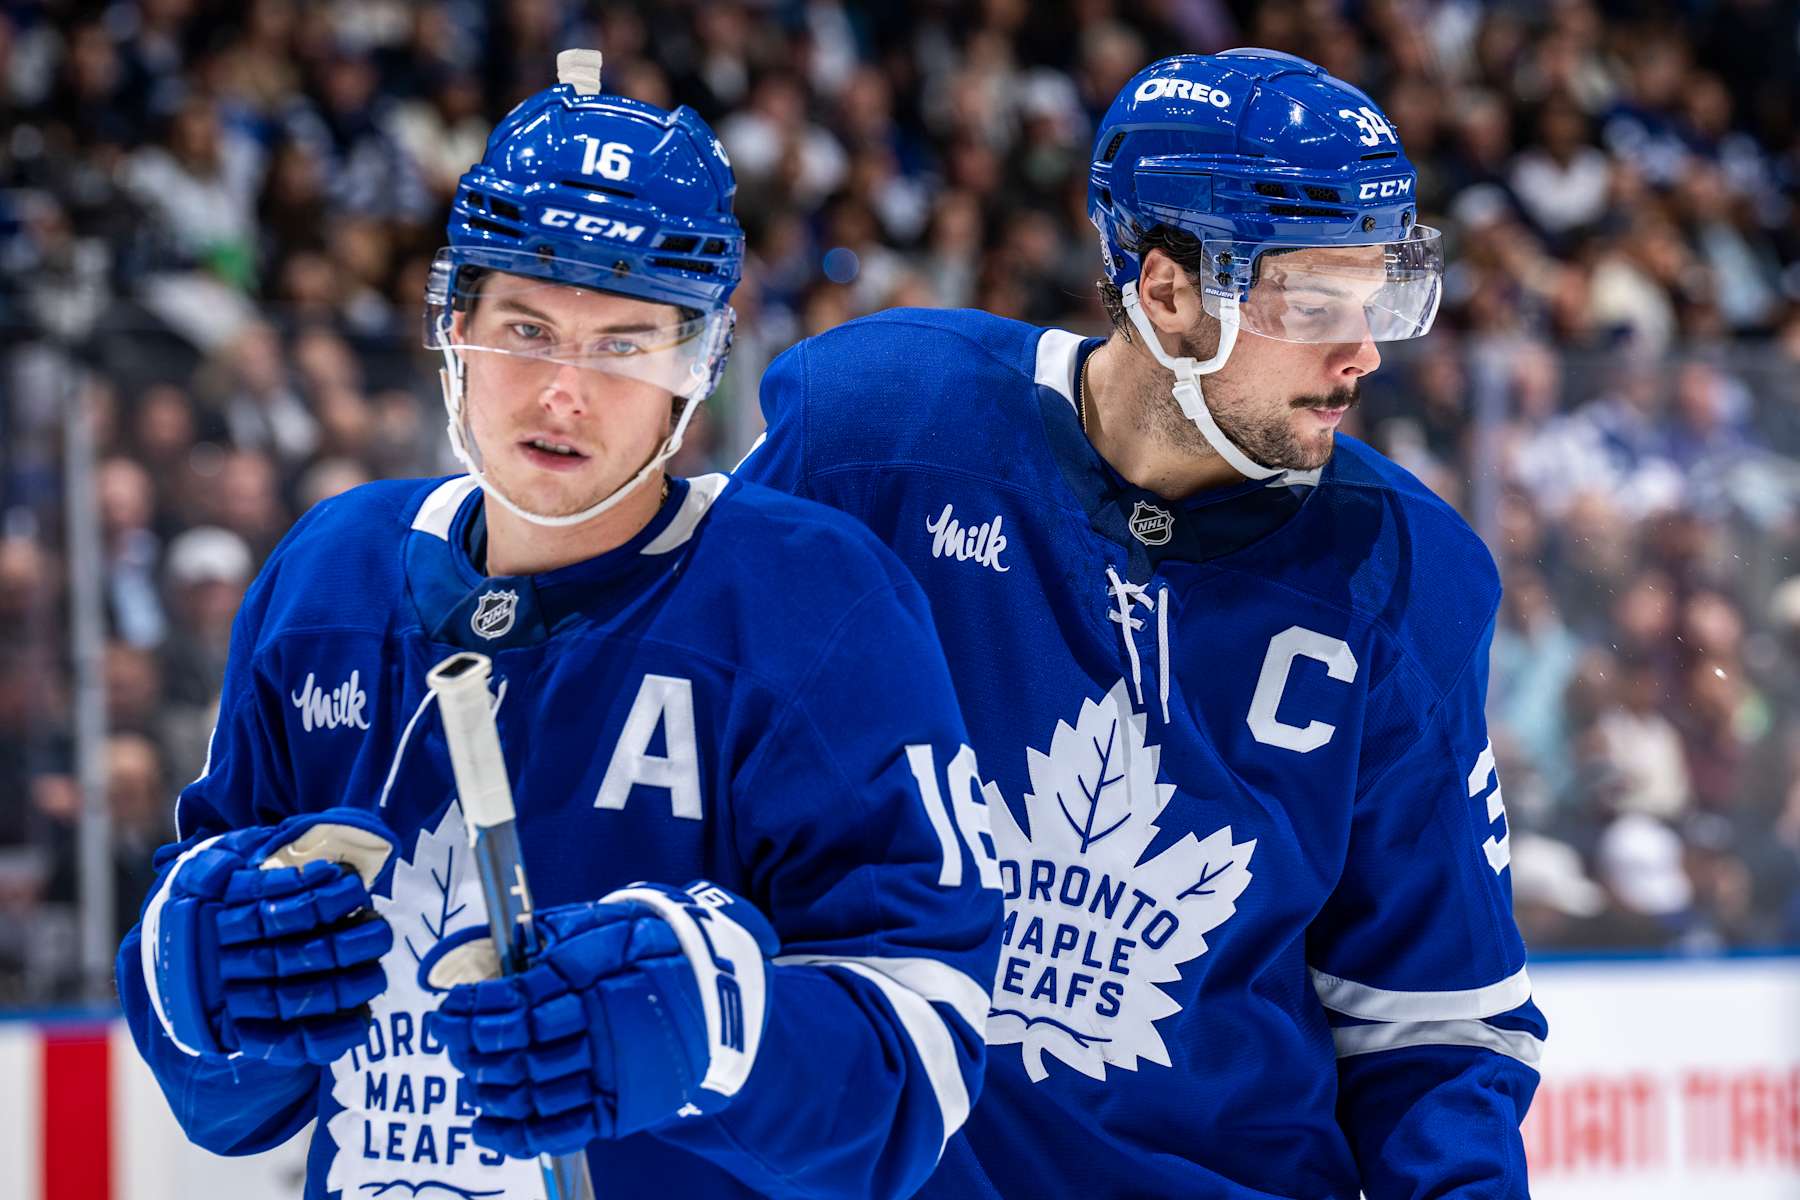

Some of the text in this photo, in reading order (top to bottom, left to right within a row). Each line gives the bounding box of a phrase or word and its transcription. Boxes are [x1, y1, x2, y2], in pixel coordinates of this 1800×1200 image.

[1134, 78, 1231, 109] OREO
[1339, 107, 1397, 147] 34
[574, 134, 633, 181] 16
[1359, 178, 1411, 200] CCM
[540, 208, 645, 243] CCM
[926, 504, 1010, 572] Milk
[1138, 519, 1165, 532] NHL
[481, 604, 510, 628] NHL
[292, 670, 370, 732] Milk
[1246, 625, 1358, 753] C
[594, 673, 702, 820] A
[999, 859, 1179, 950] ORONTO
[1002, 956, 1124, 1017] EAFS
